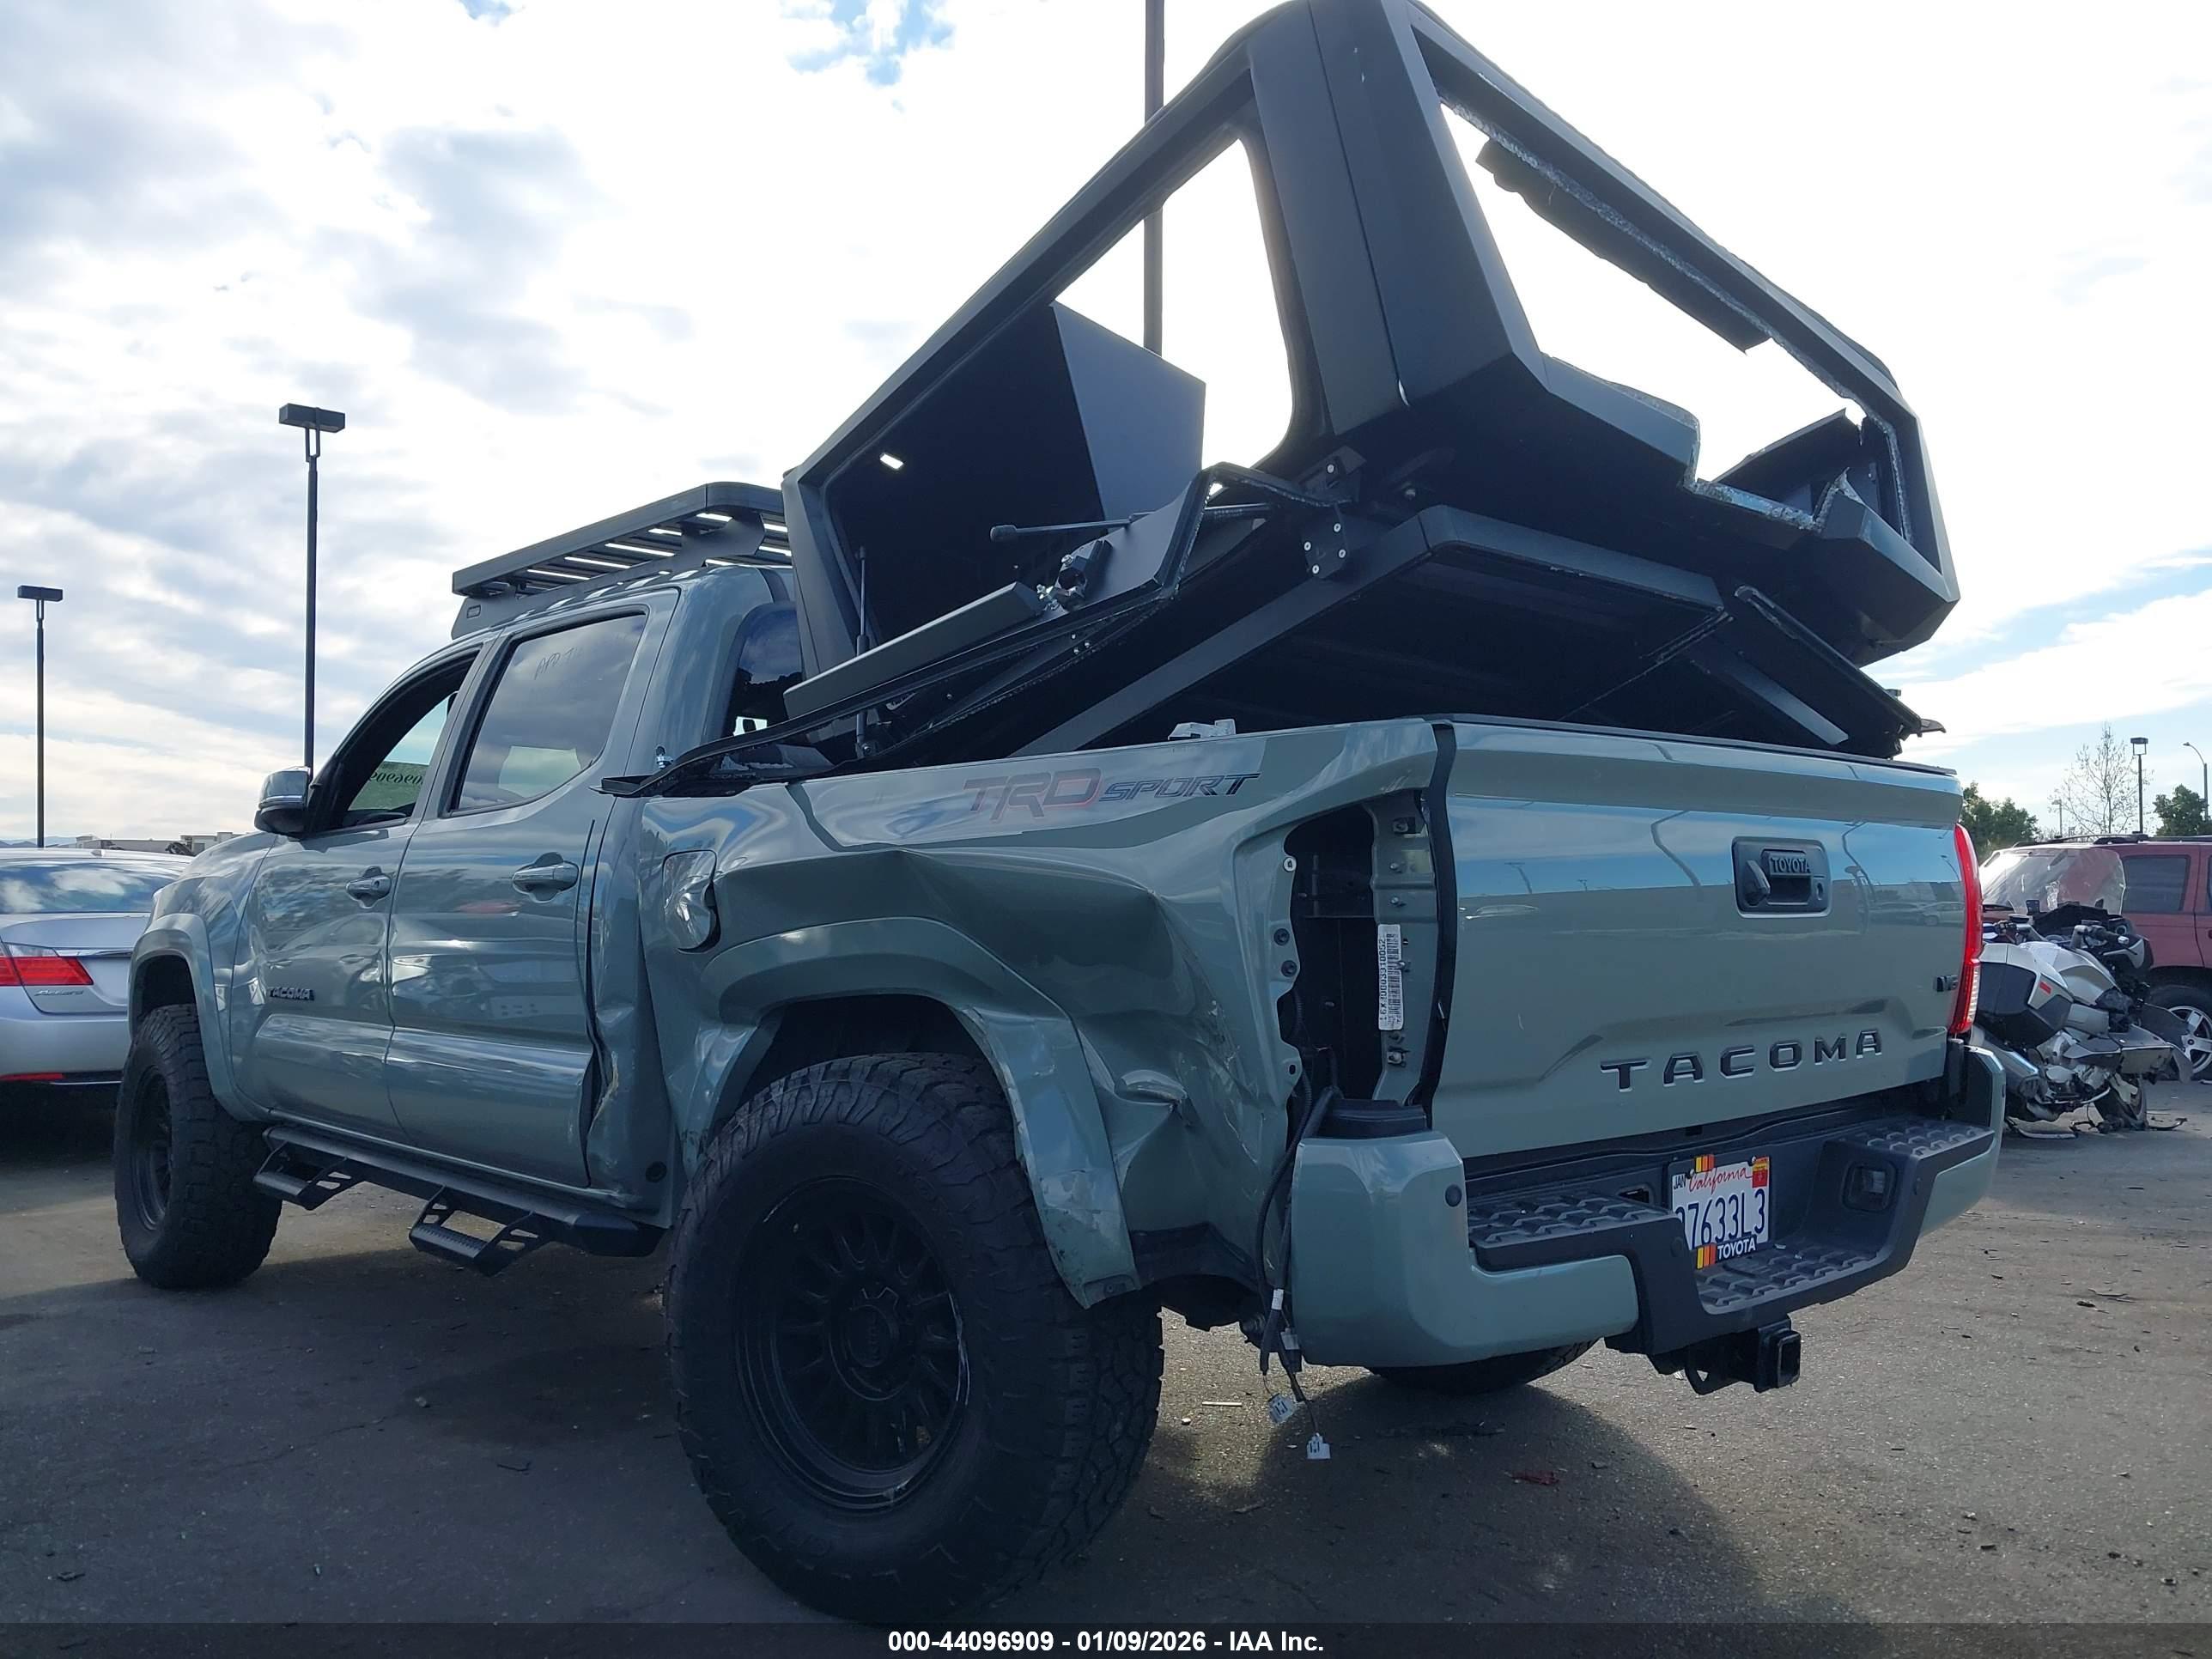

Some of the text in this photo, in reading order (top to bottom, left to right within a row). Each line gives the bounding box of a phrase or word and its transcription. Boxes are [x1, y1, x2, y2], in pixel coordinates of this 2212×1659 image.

[963, 768, 1262, 821] TRD SPORT
[1771, 857, 1812, 874] TOYOTA
[1600, 1030, 1883, 1093] TACOMA
[1674, 1167, 1752, 1195] JAN California
[1717, 1237, 1756, 1260] TOYOTA
